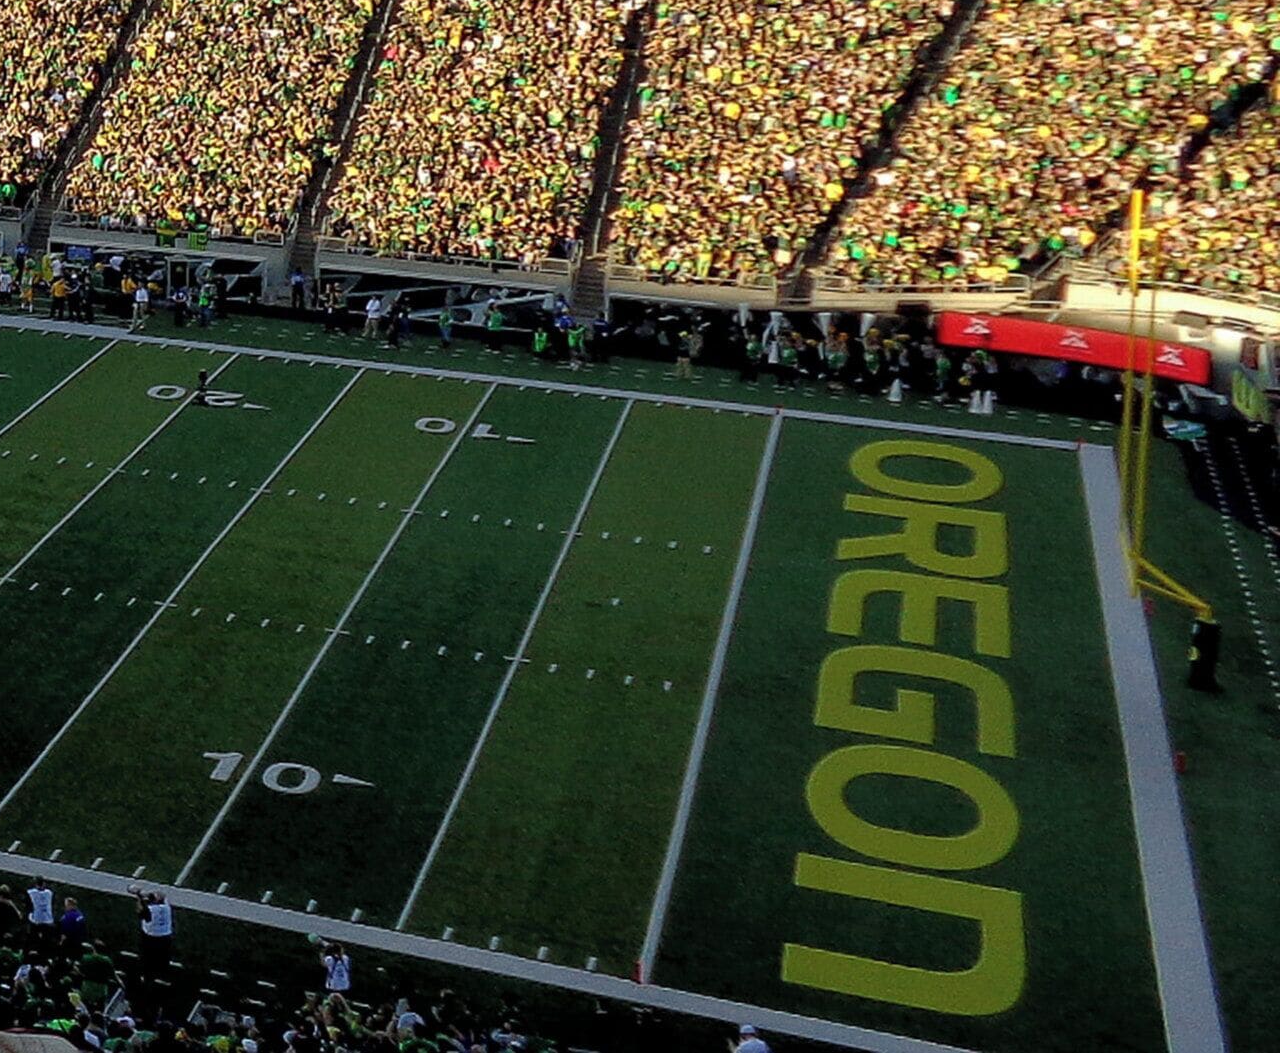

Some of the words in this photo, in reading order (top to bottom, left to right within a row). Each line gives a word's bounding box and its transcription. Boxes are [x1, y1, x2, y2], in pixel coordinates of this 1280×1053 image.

[414, 417, 501, 439] 10
[780, 440, 1027, 1016] OREGON
[202, 751, 322, 795] 10
